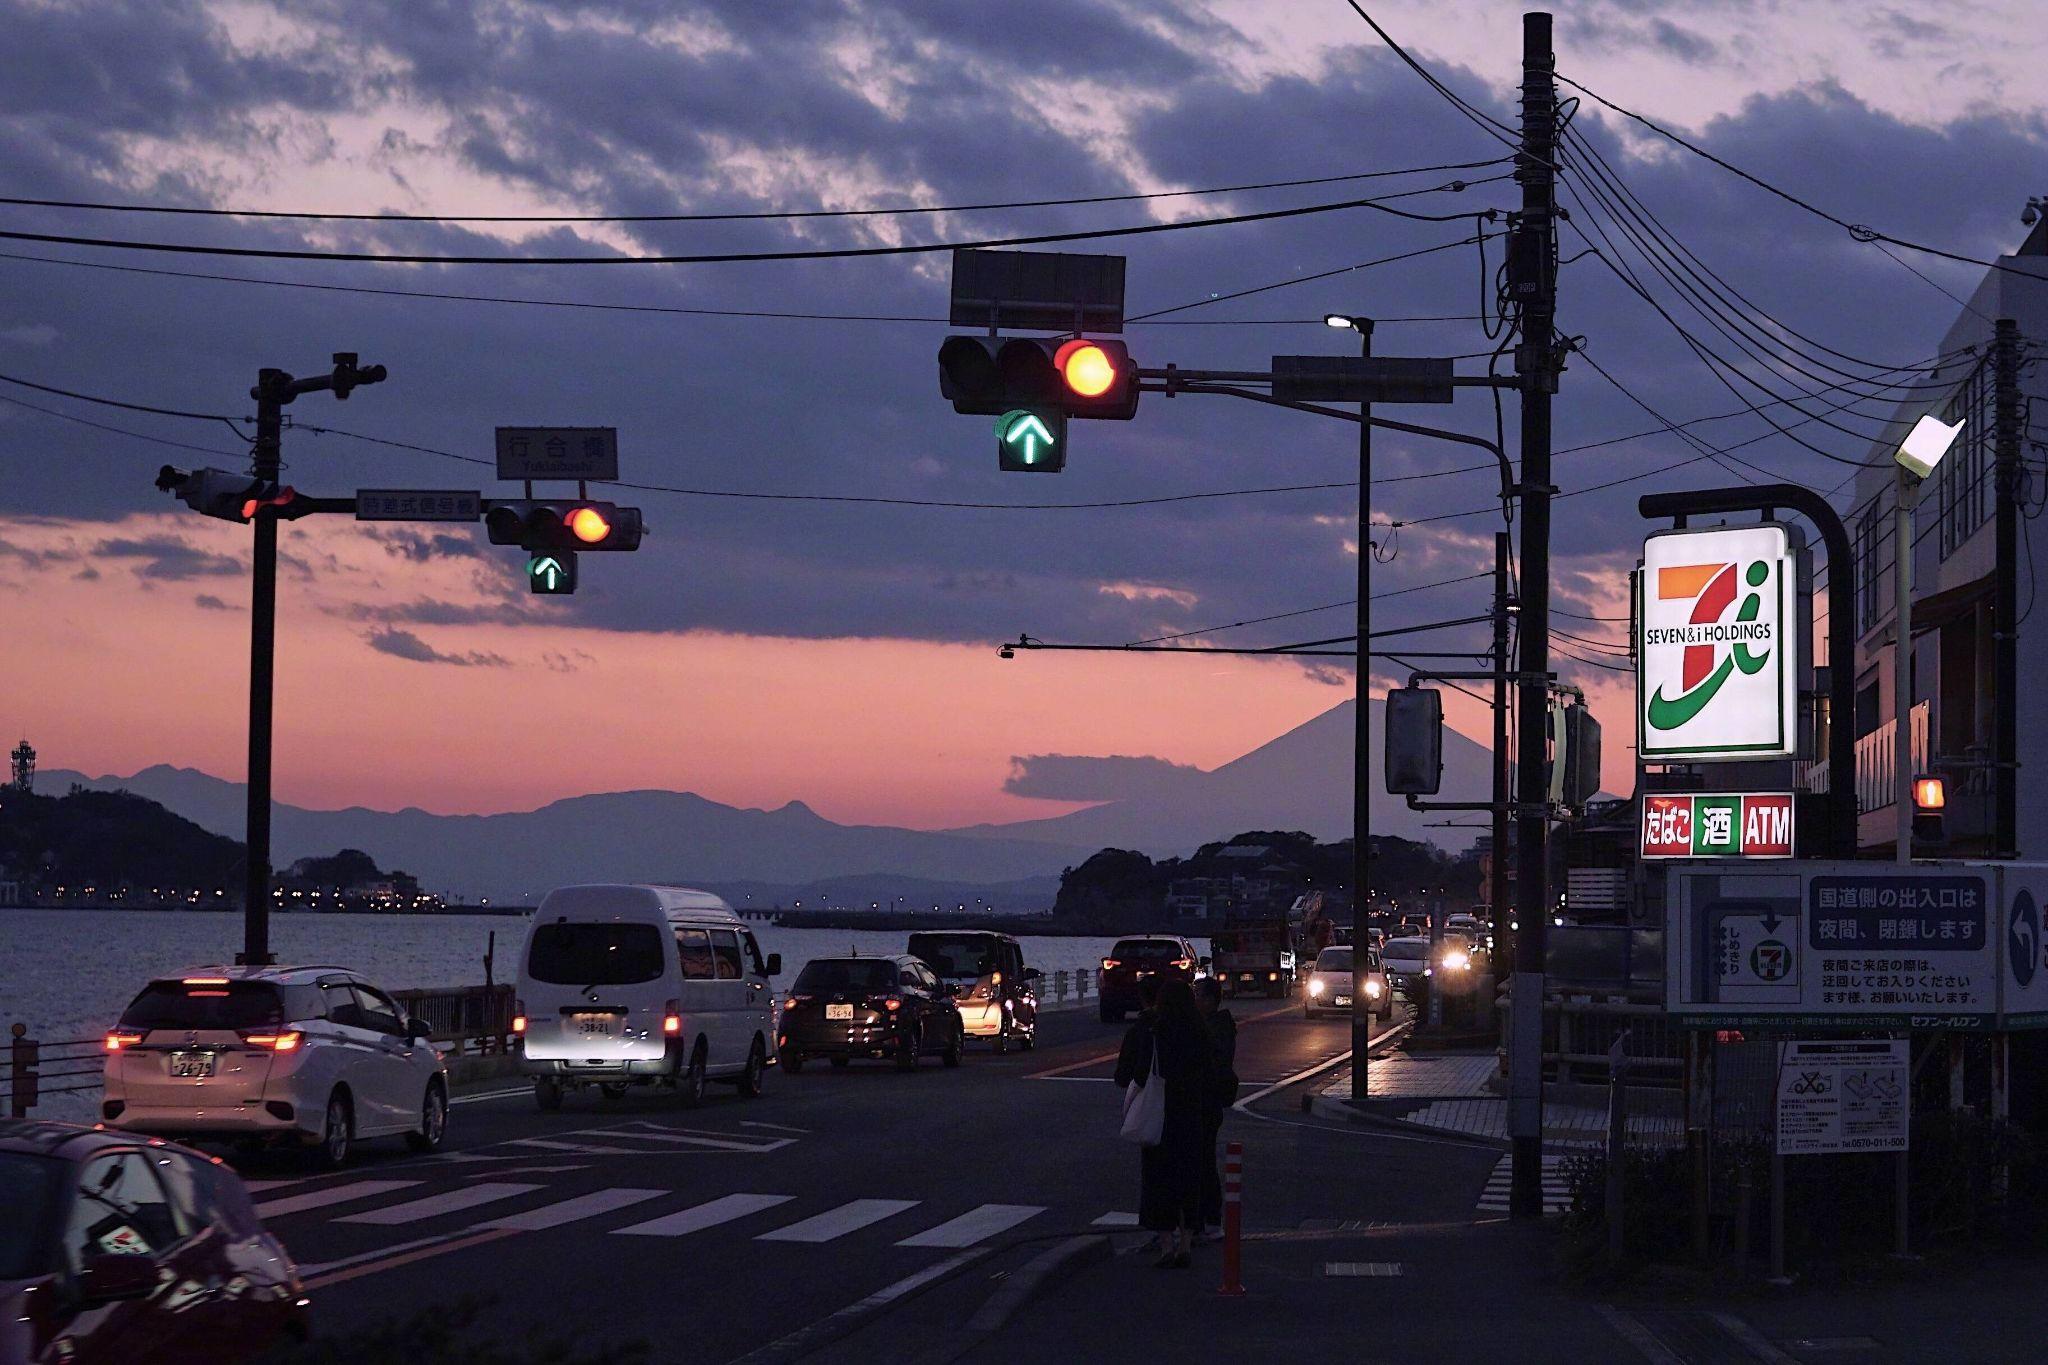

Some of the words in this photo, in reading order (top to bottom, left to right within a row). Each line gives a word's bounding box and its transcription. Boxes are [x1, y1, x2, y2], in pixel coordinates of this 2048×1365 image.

[508, 435, 606, 457] 行合橋
[363, 496, 474, 514] 時差式信号機
[1704, 623, 1771, 642] HOLDINGS
[1646, 807, 1690, 845] たばこ
[1702, 807, 1733, 846] 酒
[1745, 806, 1790, 845] ATM
[1818, 887, 1977, 908] 国道側の出入口は
[1818, 918, 1977, 940] 夜間、閉鎖します
[1730, 927, 1741, 975] しめきり
[1823, 958, 1937, 972] 夜間ご来店の際は、
[1823, 975, 1971, 988] 迂回してお入りください
